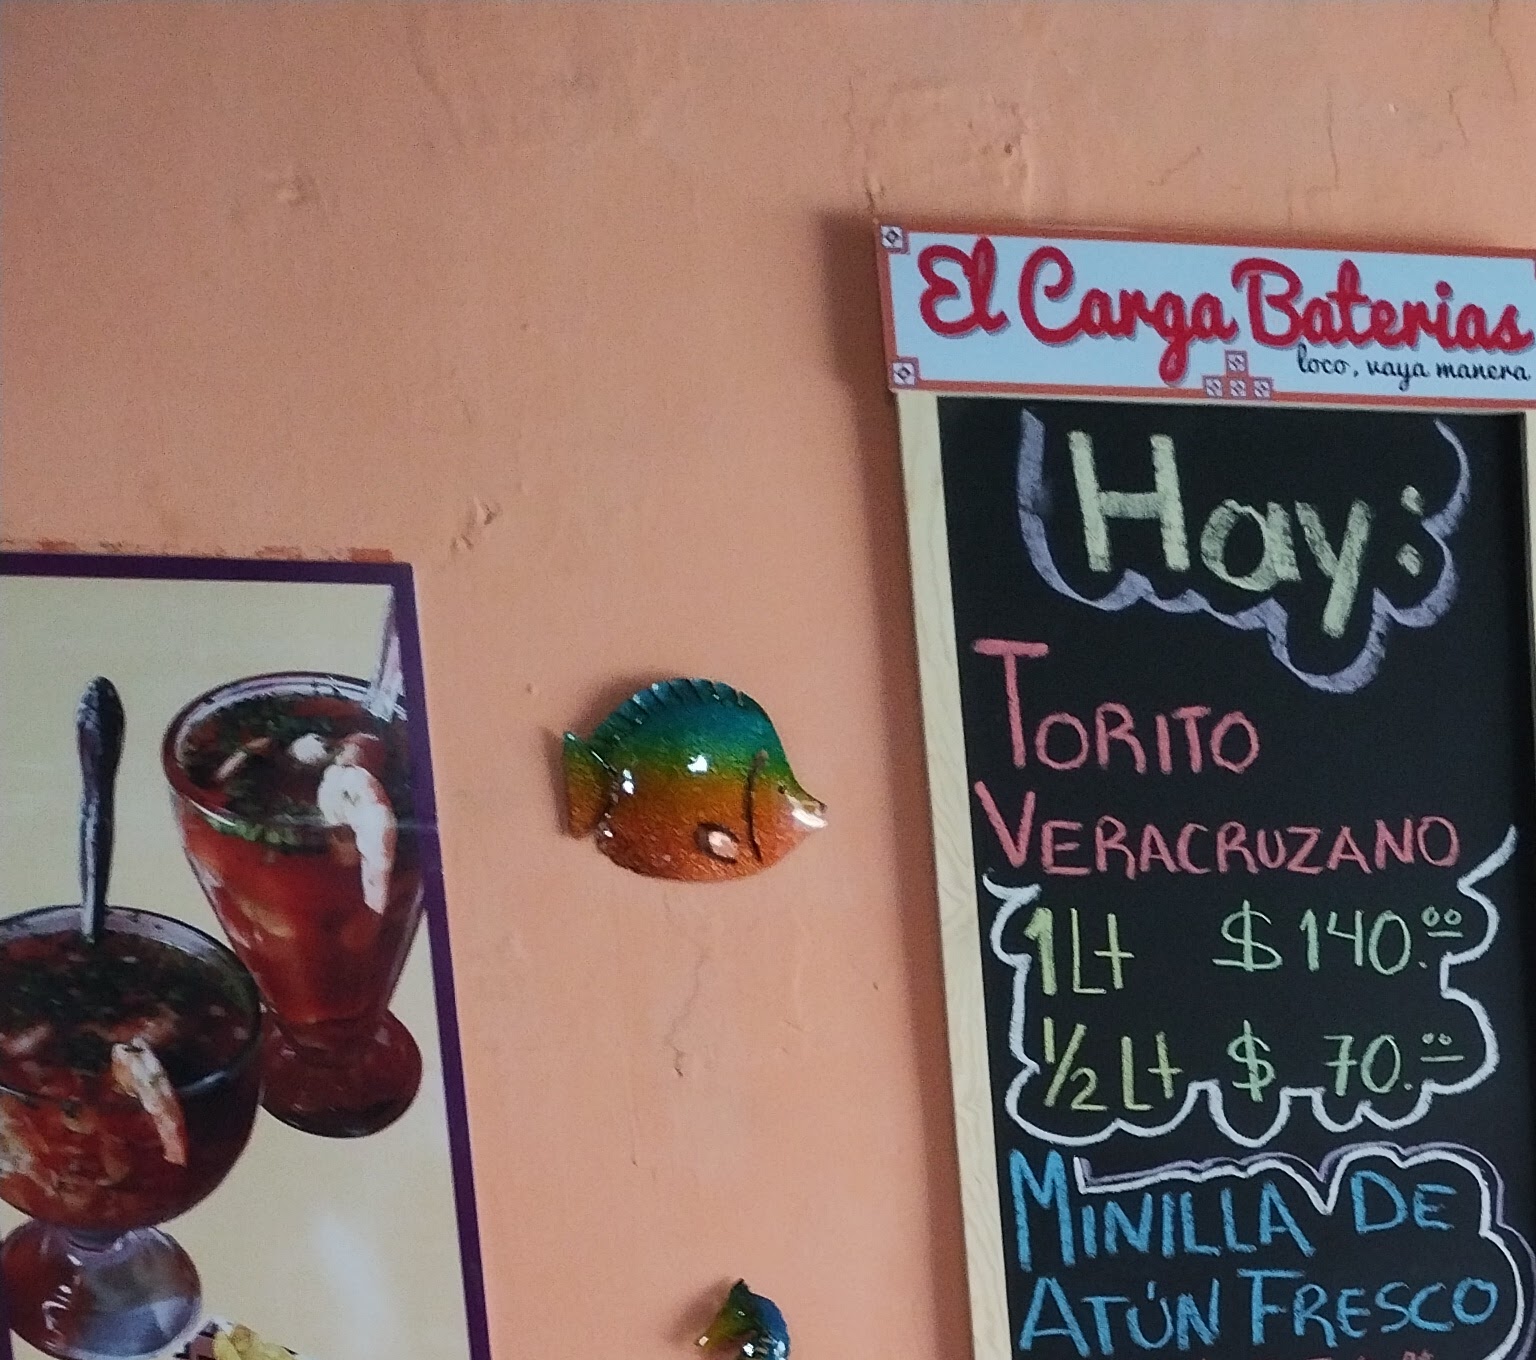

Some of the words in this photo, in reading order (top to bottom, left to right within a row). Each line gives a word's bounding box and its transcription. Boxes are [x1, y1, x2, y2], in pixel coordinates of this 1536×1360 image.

[917, 237, 1007, 336] El
[1019, 246, 1236, 383] Carga
[1231, 257, 1535, 353] Baterias
[1366, 358, 1430, 392] vaya
[1436, 362, 1531, 381] manera
[1068, 429, 1424, 638] Hay:
[973, 638, 1260, 774] TORITO
[974, 781, 1461, 880] VERACRUZANO
[1009, 1148, 1316, 1271] MINILLA
[1350, 1169, 1456, 1234] DE
[1018, 1273, 1220, 1358] ATÚN
[1237, 1268, 1499, 1348] FRESCO
